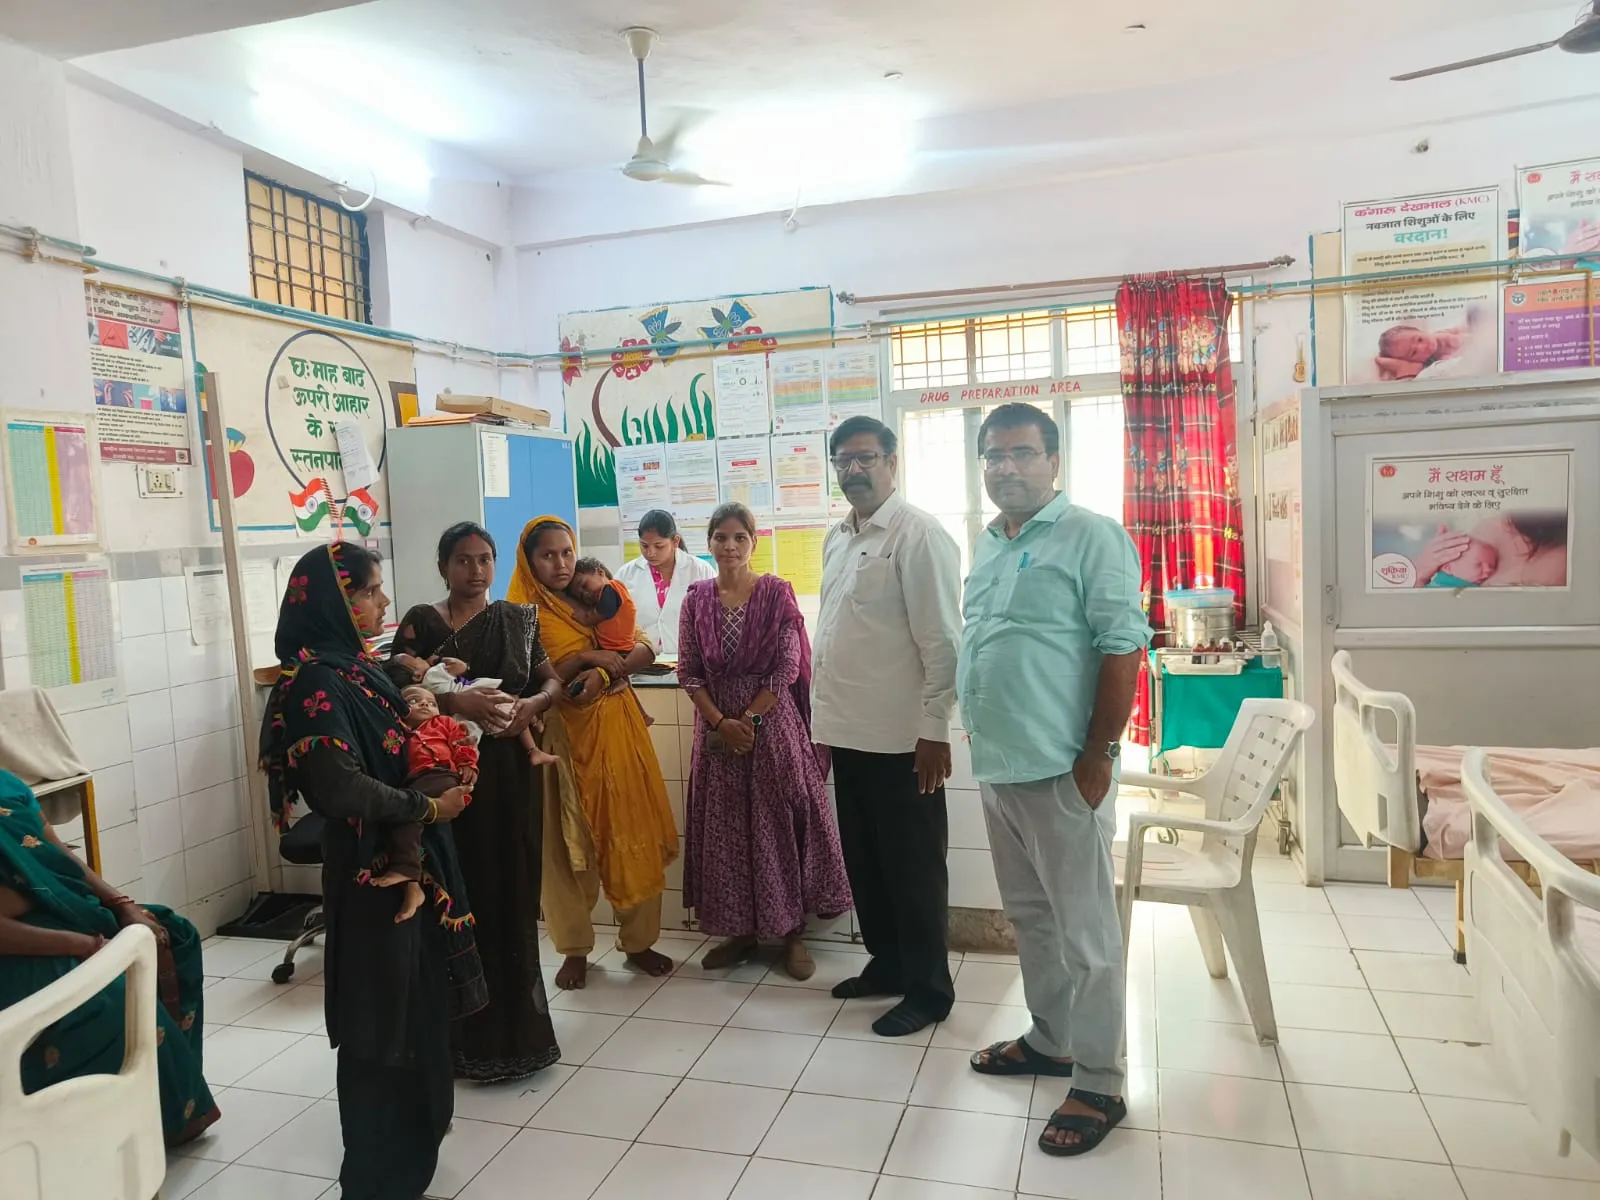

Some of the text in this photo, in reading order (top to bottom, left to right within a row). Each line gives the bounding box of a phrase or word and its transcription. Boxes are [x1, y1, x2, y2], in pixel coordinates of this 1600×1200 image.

[1400, 199, 1452, 213] देखभाल
[1454, 194, 1490, 207] (KMC)
[1365, 210, 1476, 231] नवजात शिशुओं के लिए
[1393, 227, 1449, 244] वरदान!
[311, 360, 338, 387] माह
[341, 365, 366, 388] बाद
[293, 383, 371, 419] ऊपरी आहार
[920, 381, 1082, 404] DRUG PREPARATION AREA
[305, 413, 323, 441] के
[1428, 466, 1441, 484] मैं
[1445, 468, 1487, 483] सक्षम
[1446, 488, 1459, 499] को
